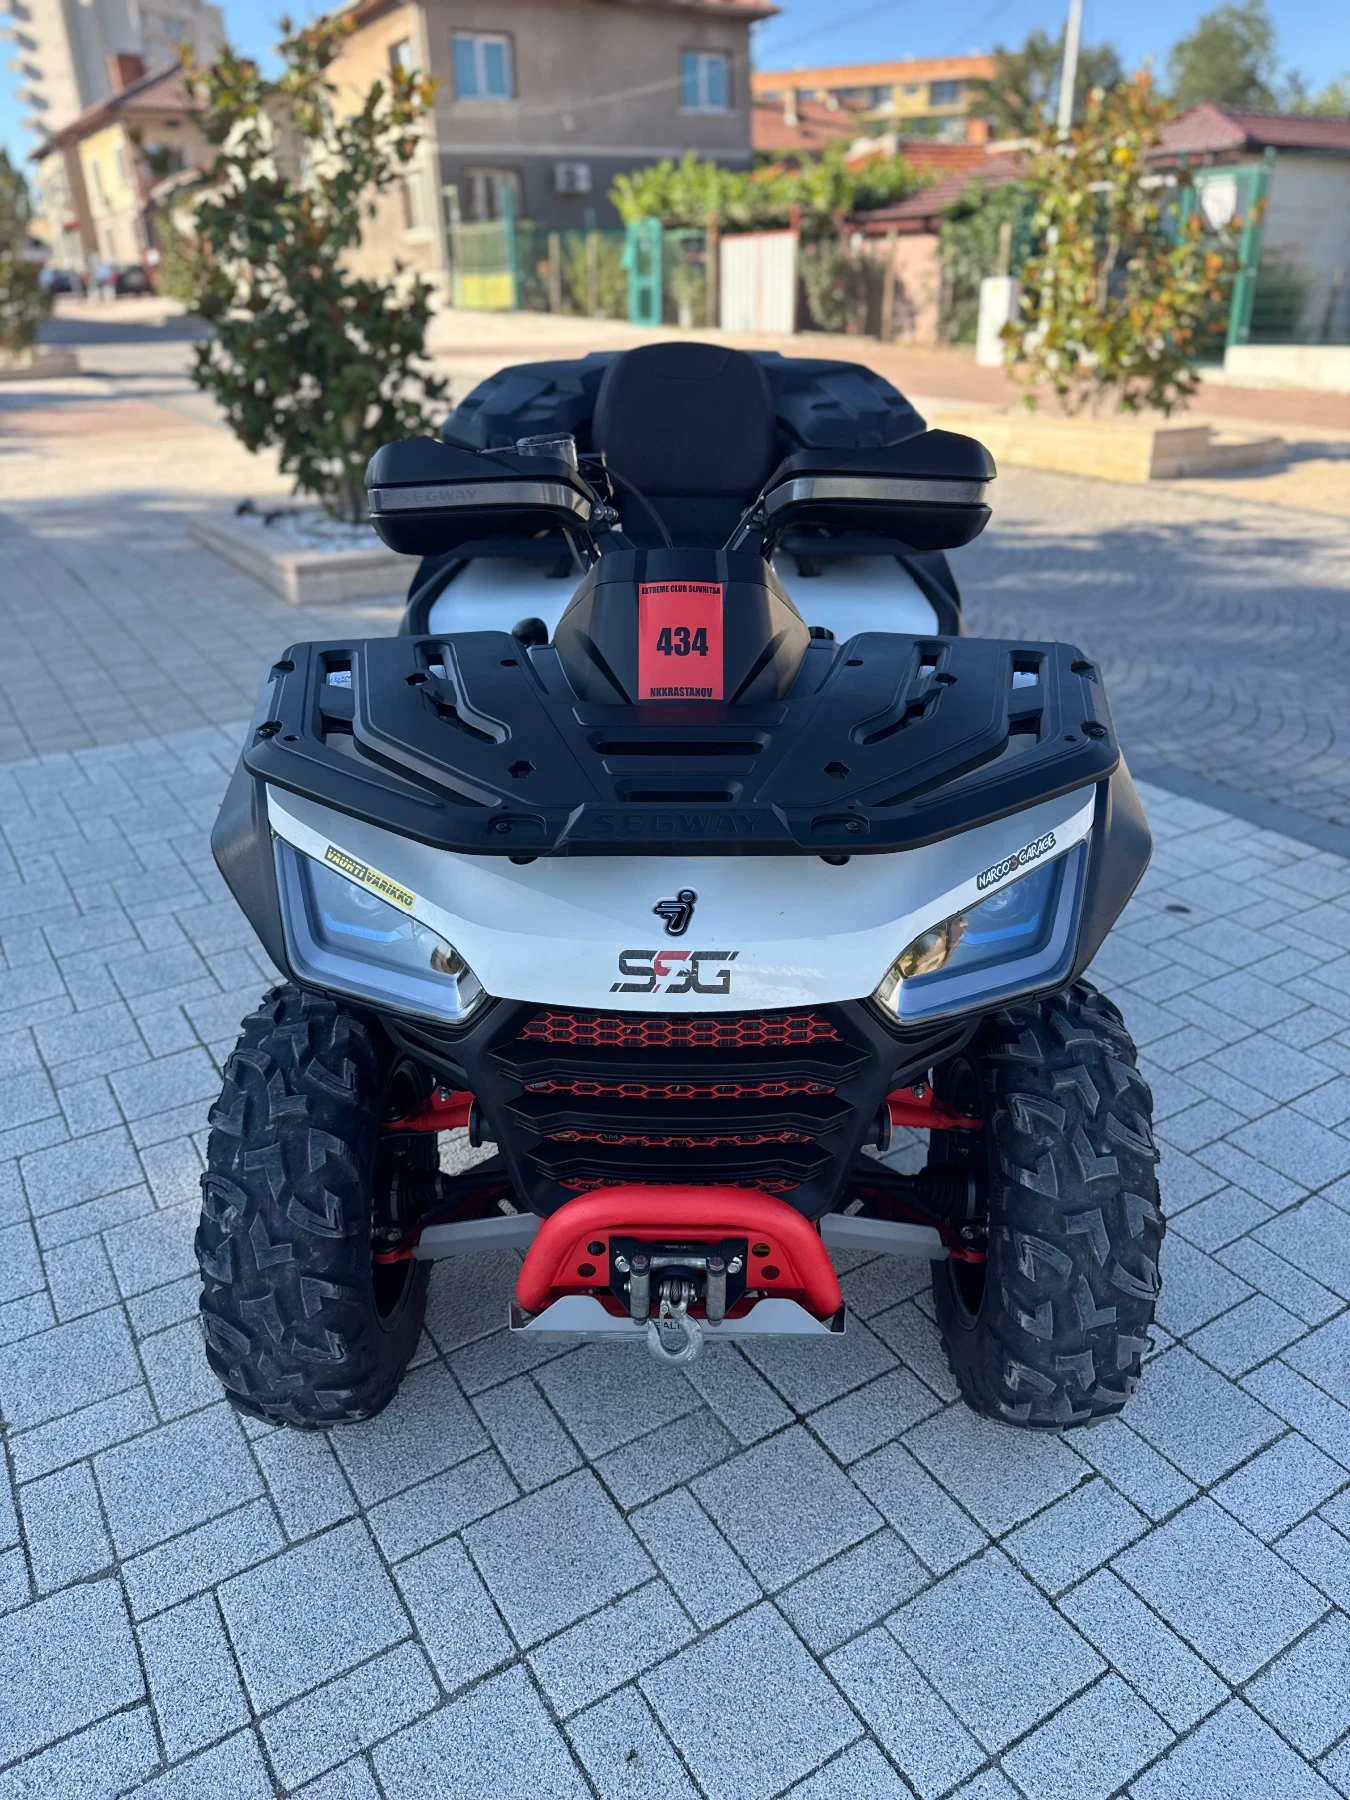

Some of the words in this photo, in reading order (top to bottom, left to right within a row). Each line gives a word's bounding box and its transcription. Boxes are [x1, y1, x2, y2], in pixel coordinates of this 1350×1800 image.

[641, 585, 670, 595] EXTREME
[670, 584, 688, 593] CLUB
[688, 585, 721, 595] SLIVNITSA
[656, 626, 709, 657] 434
[650, 686, 713, 698] NKKRASTANOV
[593, 813, 761, 833] SEGWAY
[978, 856, 1018, 889] NARCO'S
[1018, 833, 1055, 864] GARAGE
[364, 871, 414, 907] VARIKKO
